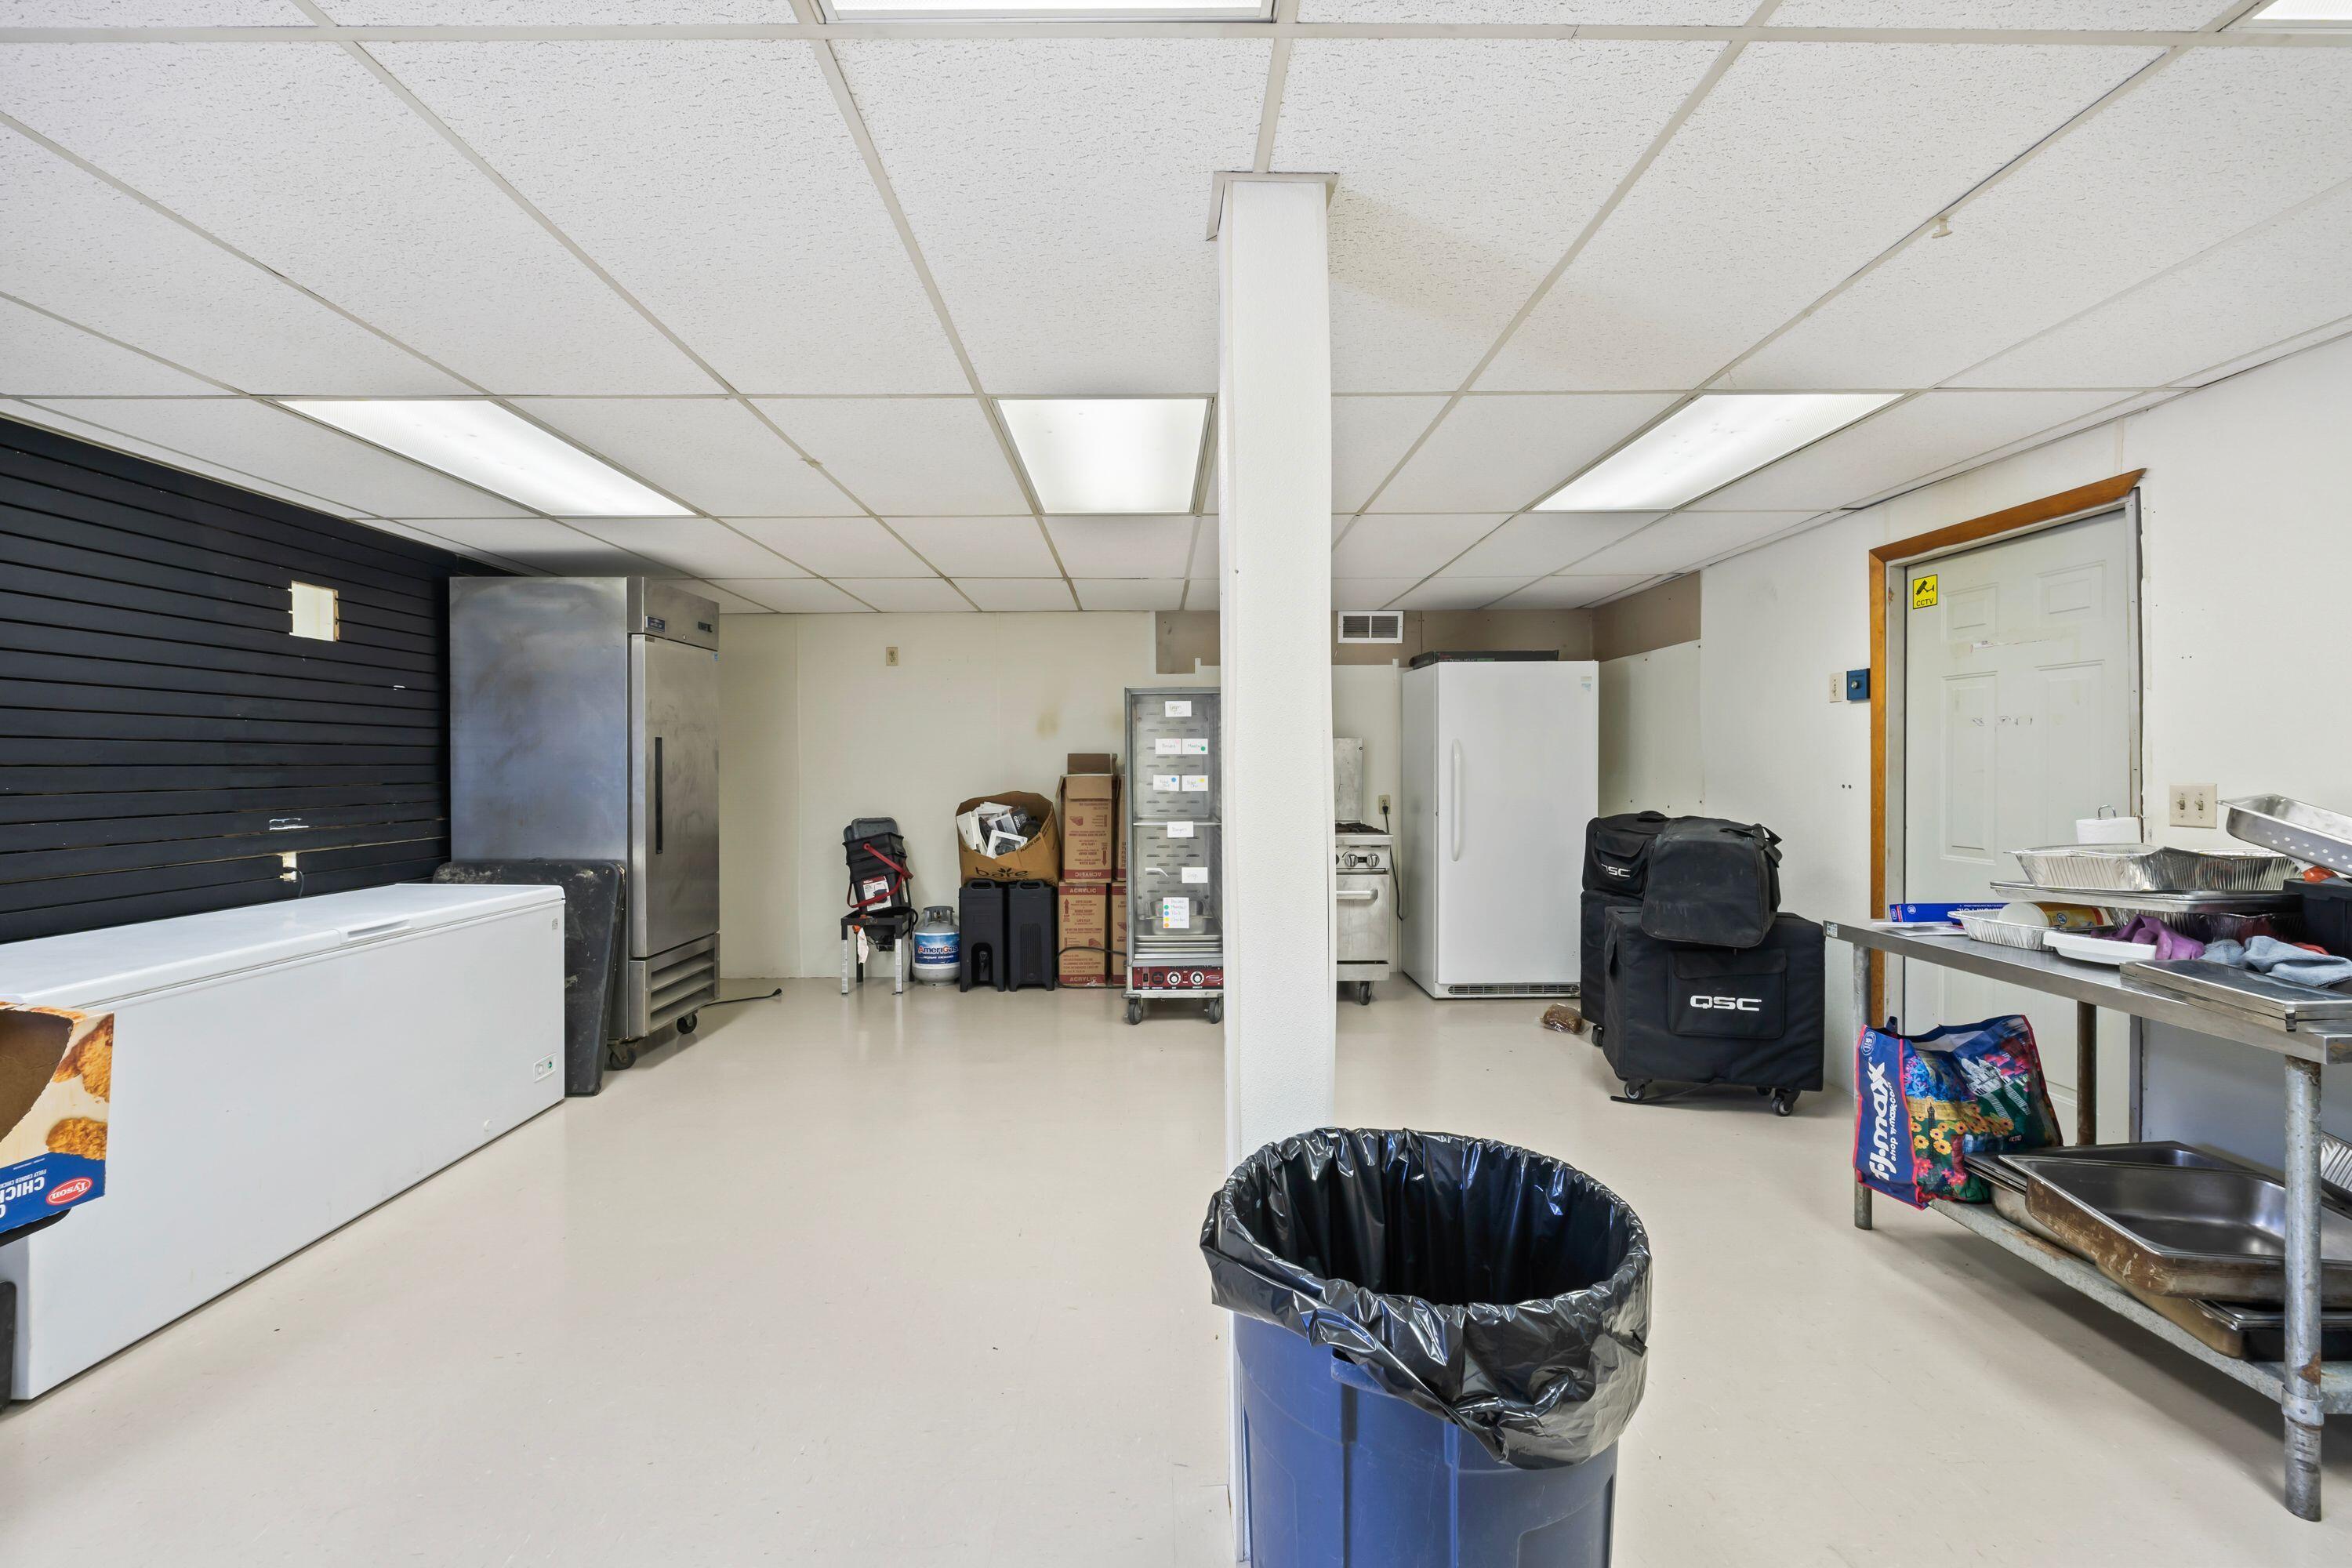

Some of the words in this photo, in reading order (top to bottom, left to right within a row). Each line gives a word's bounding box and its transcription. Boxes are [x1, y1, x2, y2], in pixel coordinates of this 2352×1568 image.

[1916, 597, 1934, 607] CCTV
[975, 866, 1029, 877] bare
[918, 945, 958, 954] AmeriGas
[1690, 994, 1762, 1011] QSC
[49, 1181, 88, 1200] Tyson
